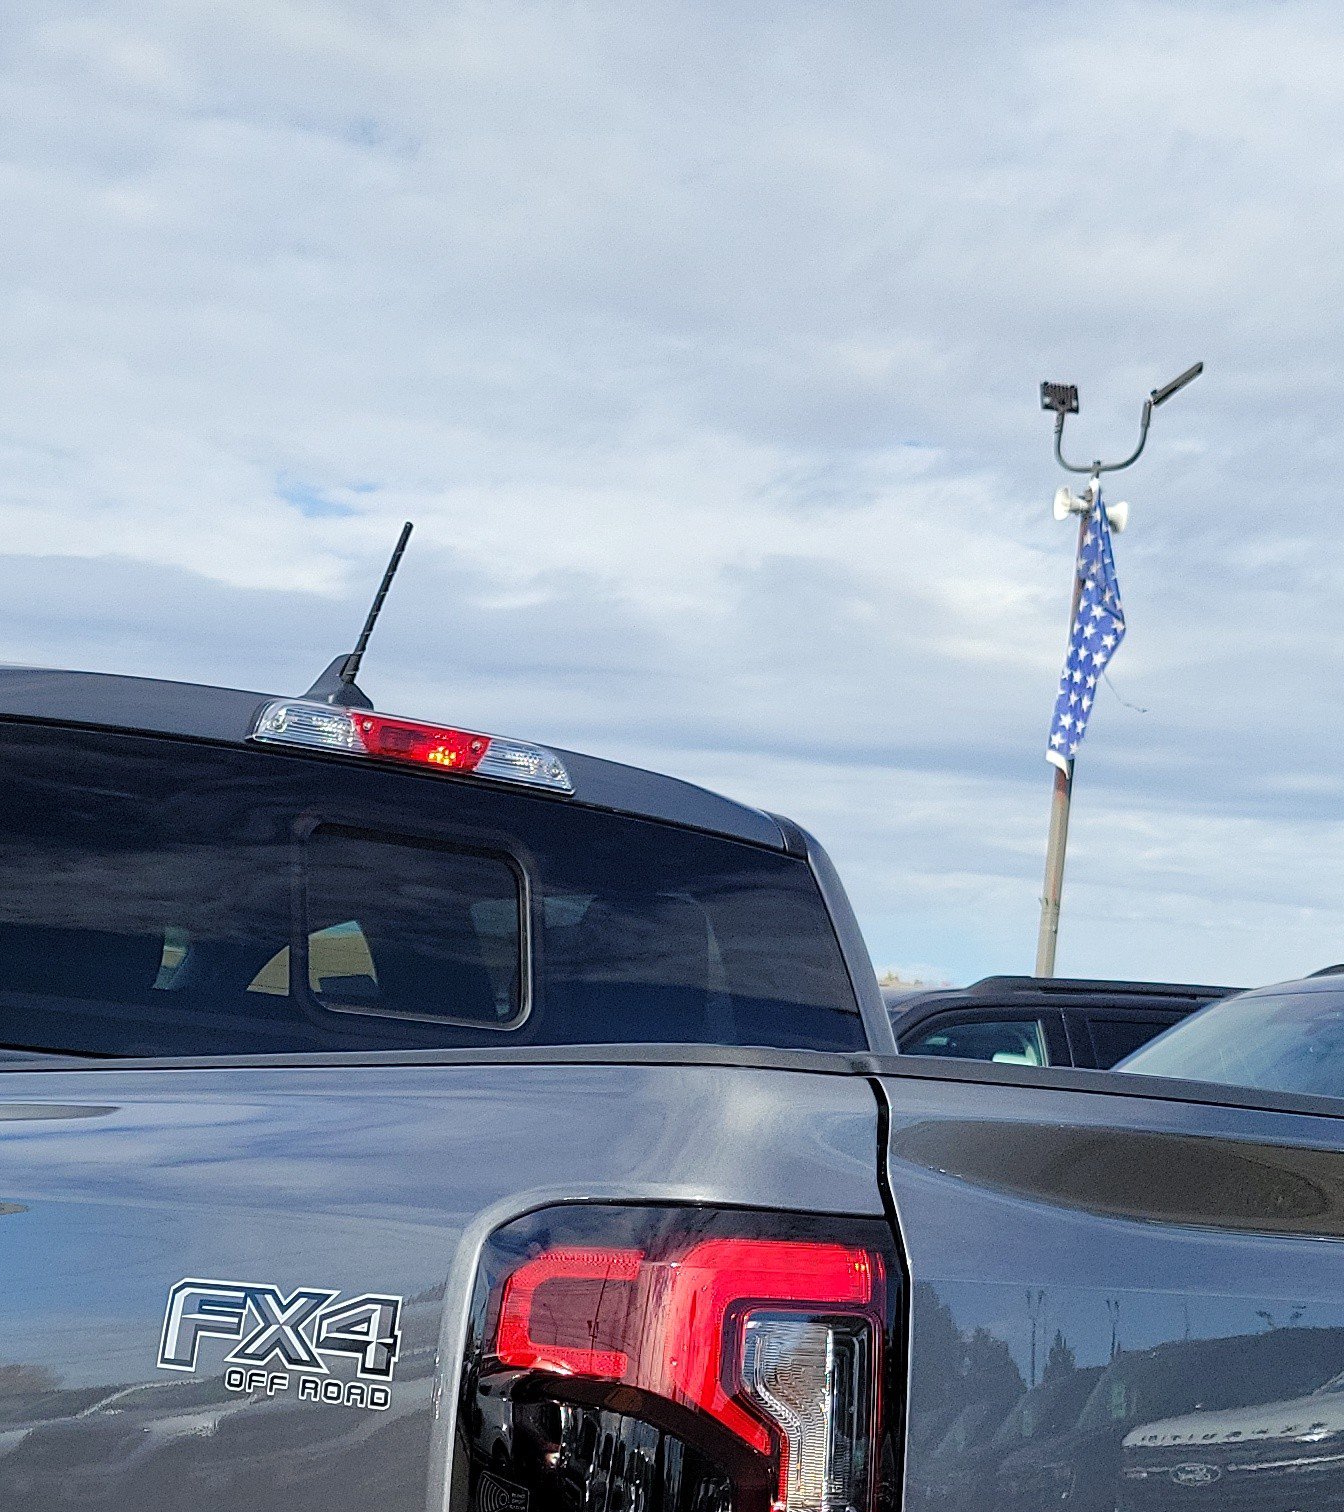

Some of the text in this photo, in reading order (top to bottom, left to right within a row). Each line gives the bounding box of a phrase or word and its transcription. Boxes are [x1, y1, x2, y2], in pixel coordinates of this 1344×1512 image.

[156, 1277, 403, 1382] FX4
[225, 1366, 392, 1411] OFF ROAD
